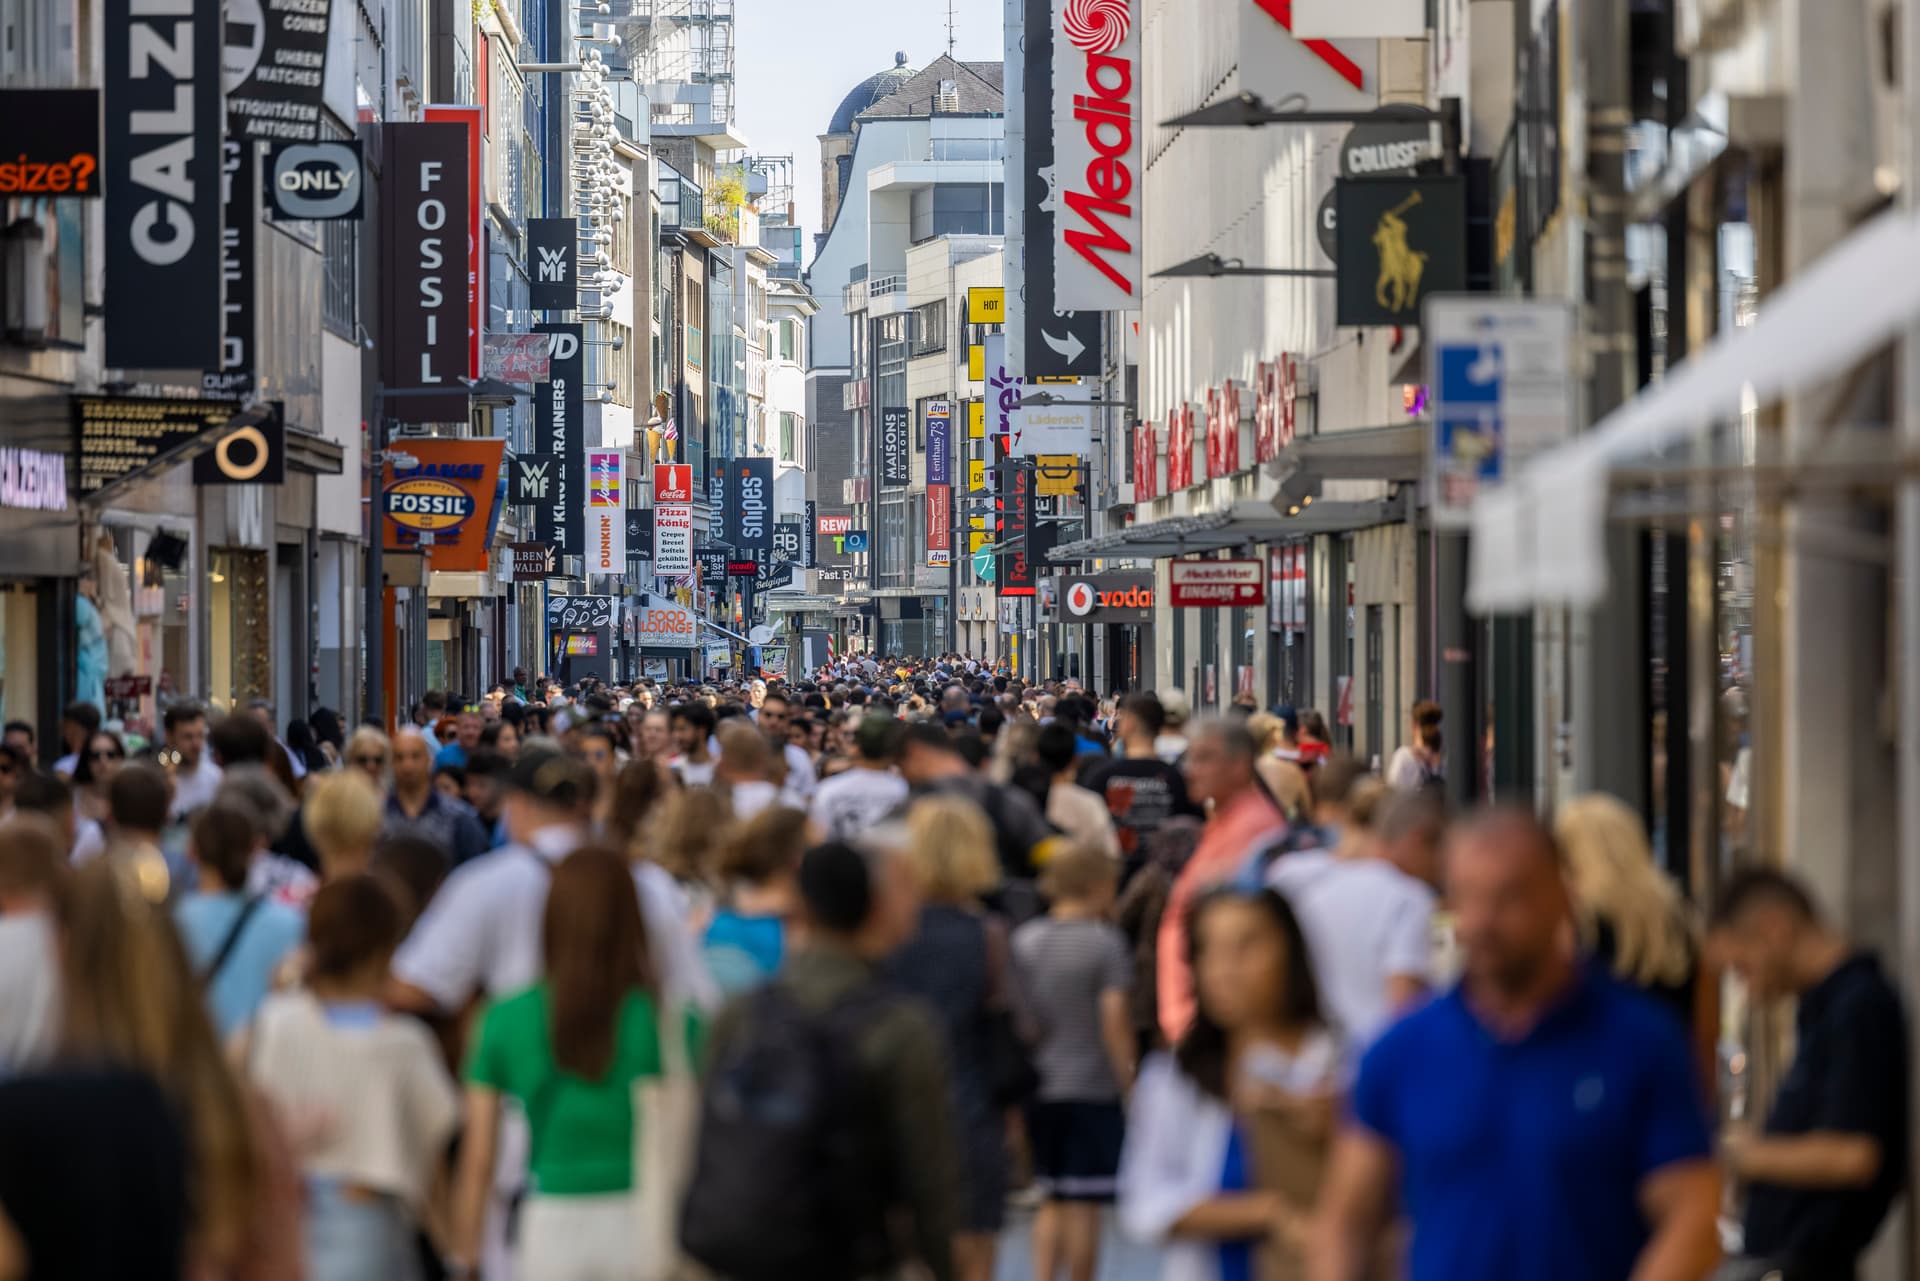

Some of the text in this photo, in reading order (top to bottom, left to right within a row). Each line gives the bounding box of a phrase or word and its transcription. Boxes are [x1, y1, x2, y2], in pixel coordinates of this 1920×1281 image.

[283, 14, 326, 33] COINS
[274, 49, 323, 67] UHREN
[256, 65, 321, 87] WATCHES
[246, 119, 316, 140] ANTIQUES
[0, 153, 96, 191] size?
[279, 168, 356, 191] ONLY
[1064, 51, 1132, 296] Media
[417, 162, 446, 383] FOSSIL
[983, 300, 998, 310] HOT
[931, 403, 946, 412] dm
[886, 413, 897, 479] MAISONS
[596, 453, 617, 508] jamin
[390, 494, 466, 514] FOSSIL
[658, 508, 687, 516] Pizza
[742, 476, 767, 538] snipes
[657, 518, 689, 529] König
[600, 514, 611, 568] DUNKIN'
[513, 551, 544, 561] LBEN
[931, 552, 947, 561] dm
[1010, 541, 1026, 581] Foo
[1179, 585, 1236, 601] EINGANG
[647, 610, 687, 622] FOOD
[641, 622, 693, 634] LOUNGE
